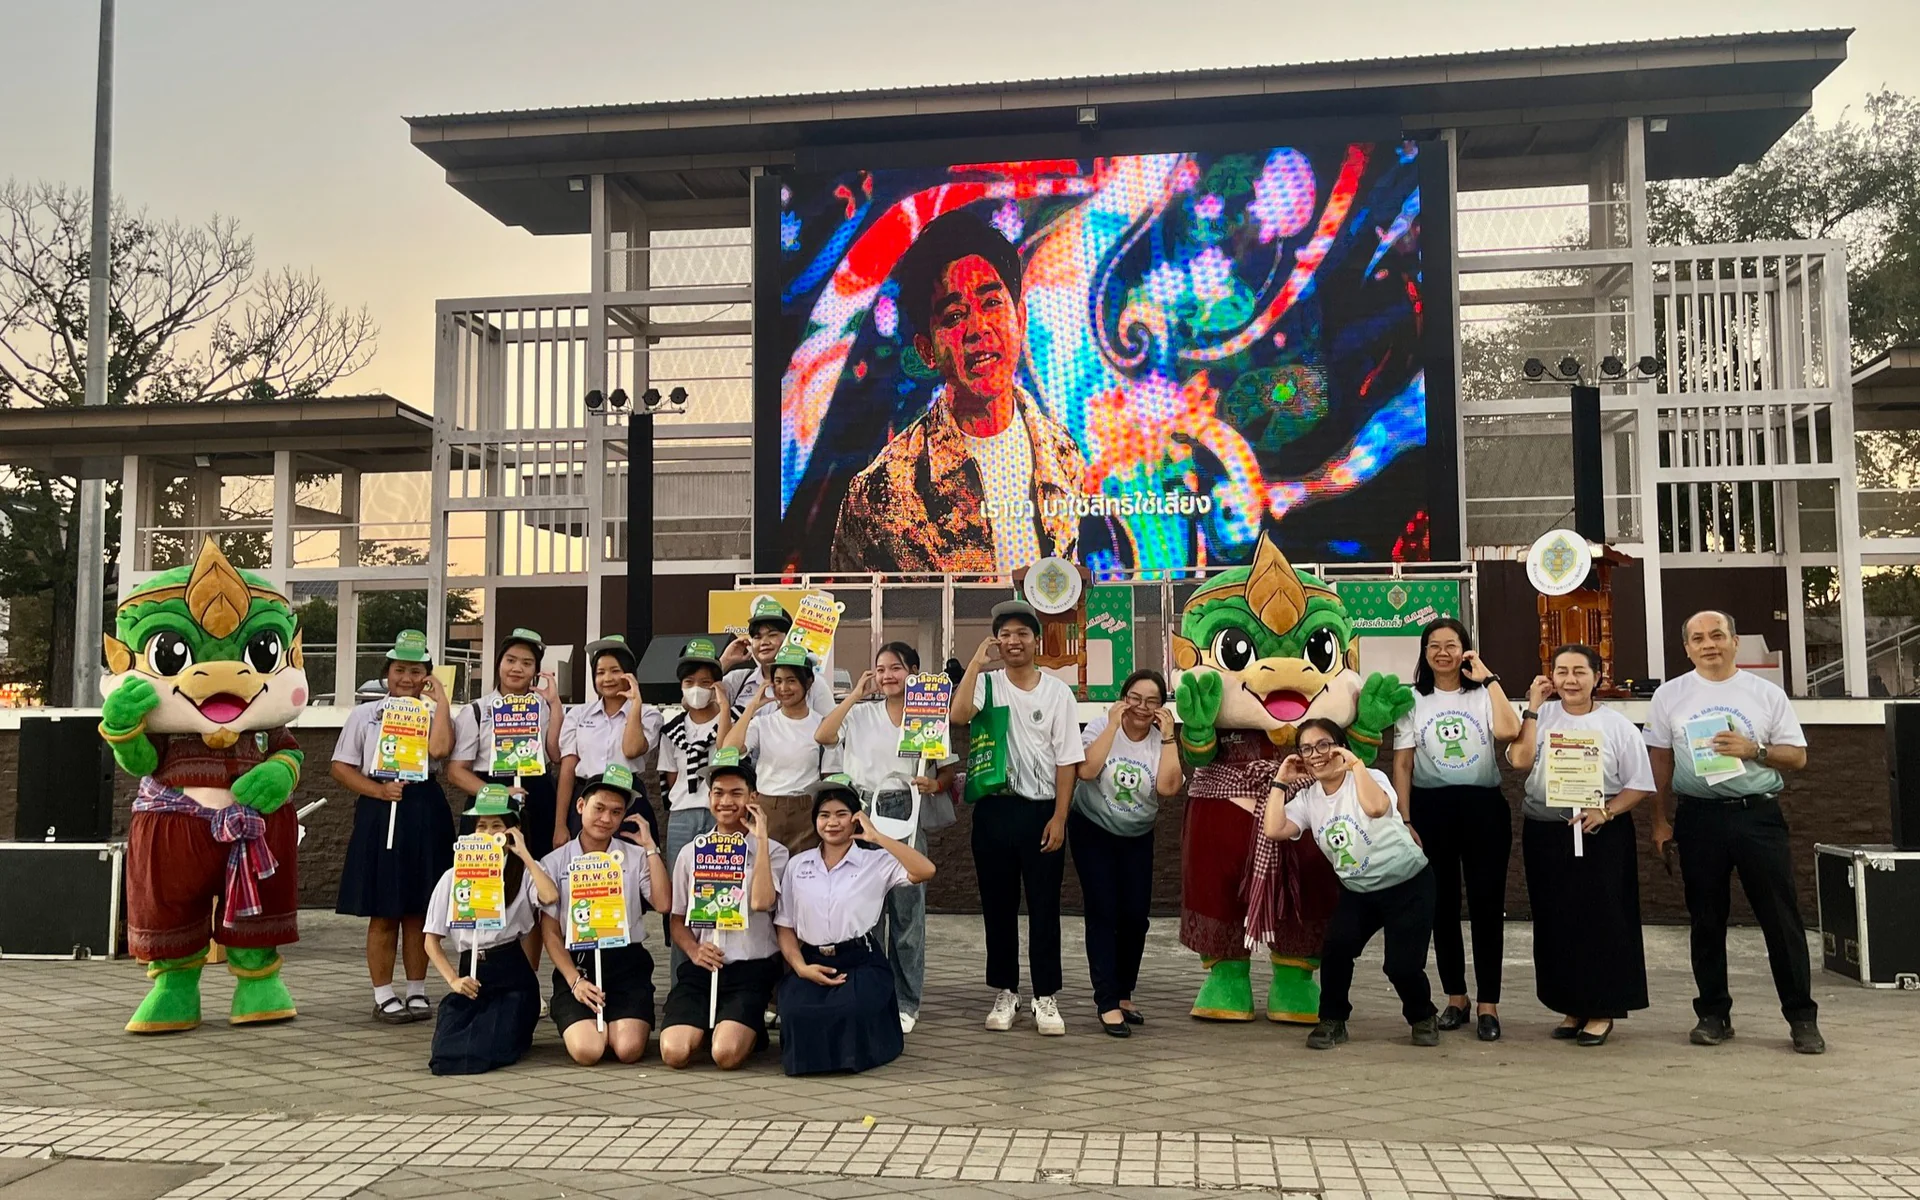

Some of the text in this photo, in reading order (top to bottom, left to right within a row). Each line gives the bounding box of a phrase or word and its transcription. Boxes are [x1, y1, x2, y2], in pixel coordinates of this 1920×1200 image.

[980, 499, 1035, 518] เรามา
[416, 715, 427, 723] 69
[715, 844, 736, 854] สส.
[489, 853, 500, 861] 69
[696, 854, 704, 864] 8
[730, 855, 744, 865] 69
[573, 871, 618, 882] 8 ก.พ. 69
